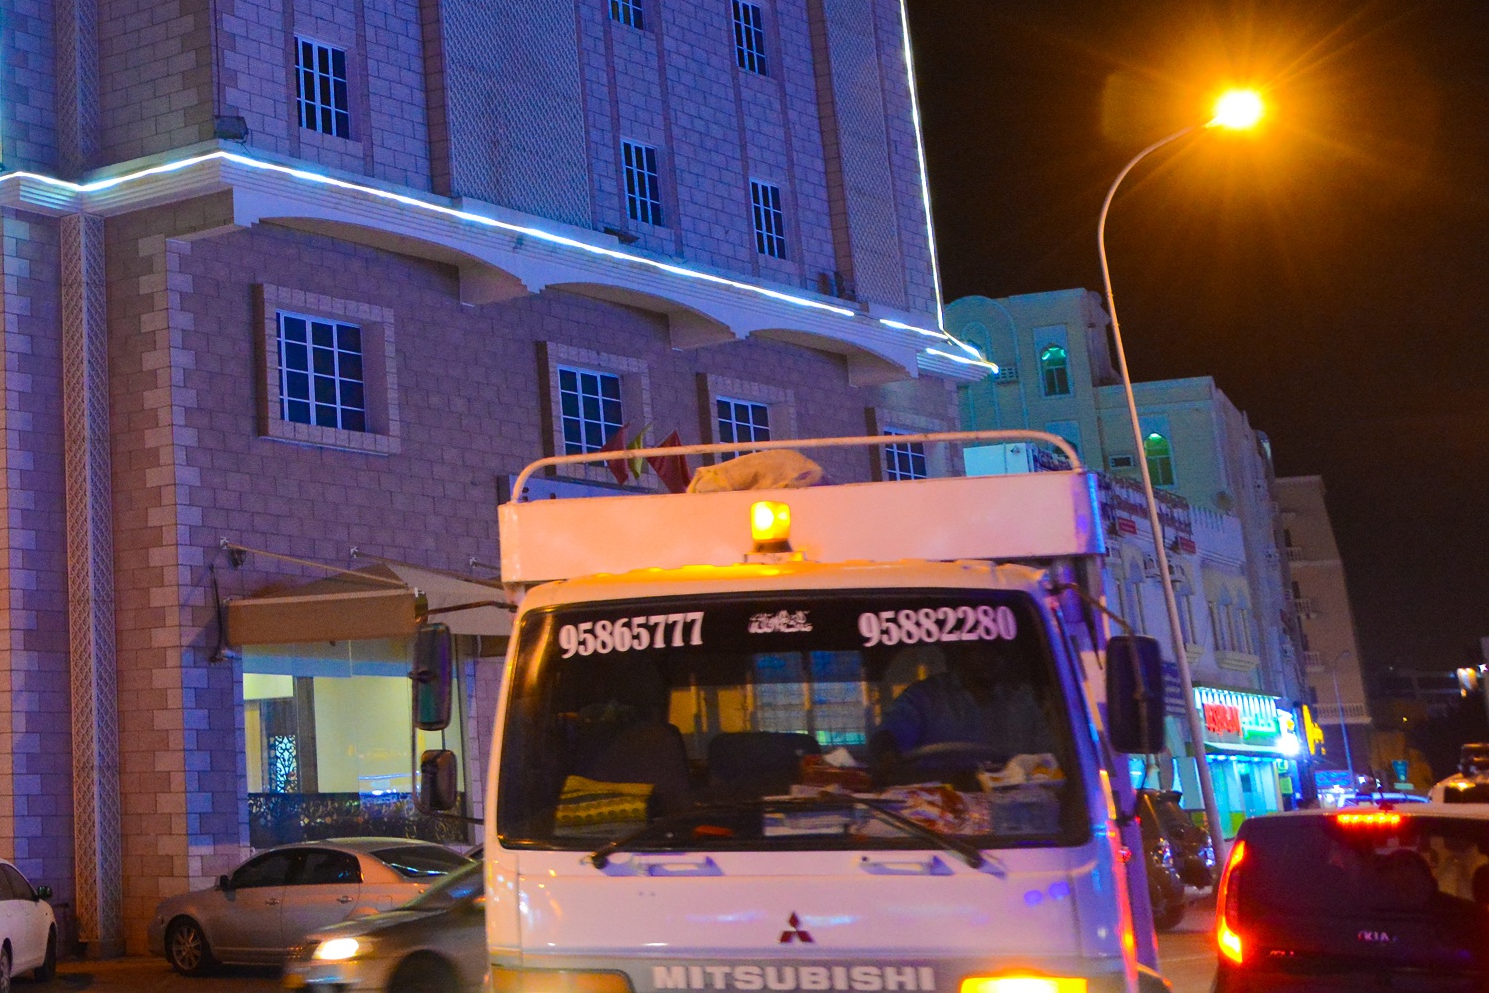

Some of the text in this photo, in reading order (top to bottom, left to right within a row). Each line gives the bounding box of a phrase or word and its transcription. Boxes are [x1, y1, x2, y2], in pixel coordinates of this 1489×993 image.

[559, 611, 704, 658] 95865777
[858, 606, 1017, 647] 95882280
[1363, 931, 1390, 942] KIA
[653, 965, 936, 991] MITSUBISHI
